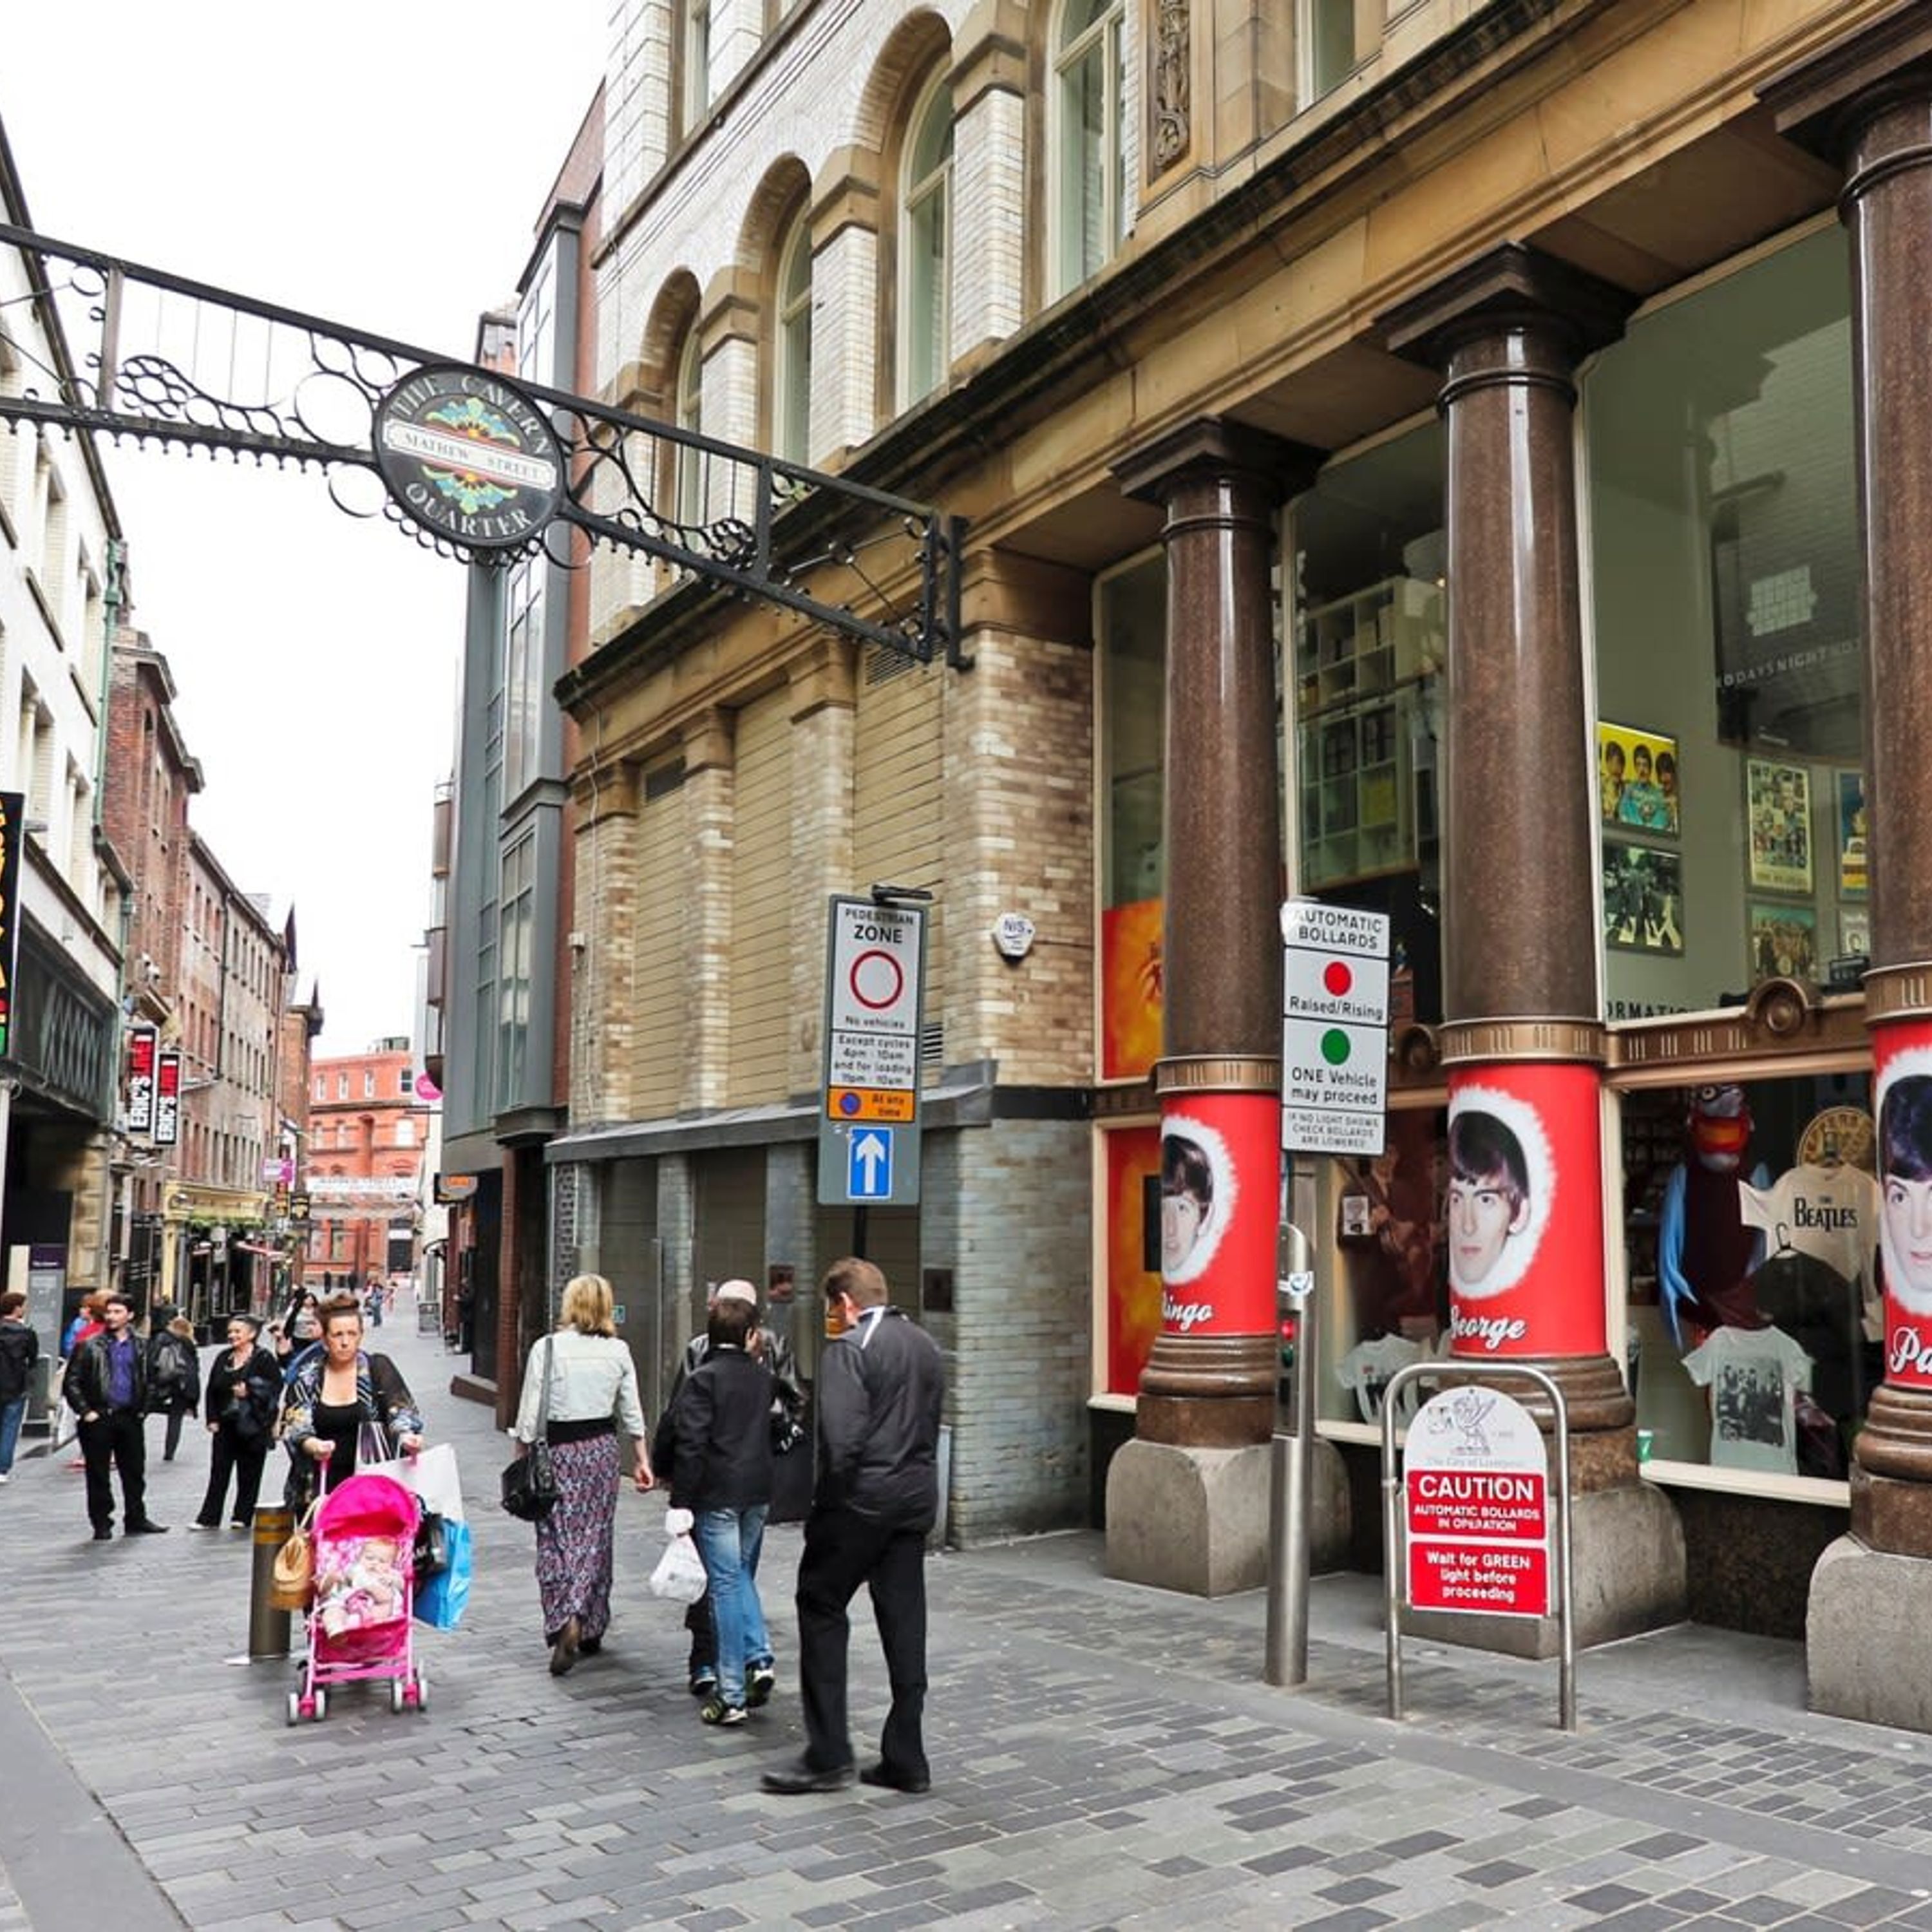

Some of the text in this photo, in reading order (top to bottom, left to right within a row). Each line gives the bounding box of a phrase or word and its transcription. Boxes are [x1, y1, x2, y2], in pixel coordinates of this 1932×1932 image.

[389, 375, 552, 455] THE CAVERN
[406, 483, 532, 537] QUARTER
[845, 907, 914, 925] PEDESTRIAN
[1302, 910, 1382, 933] UTOMATIC
[854, 924, 903, 943] ZONE
[1298, 926, 1378, 949] BOLLARDS
[1290, 996, 1383, 1021] Raised/Rising
[838, 1034, 911, 1050] Except cycles
[1292, 1066, 1377, 1088] ONE Vehicle
[1292, 1088, 1378, 1105] may proceed
[1292, 1122, 1324, 1134] CHECK
[1794, 1197, 1858, 1232] BEATLES
[1419, 1475, 1534, 1501] CAUTION
[1414, 1504, 1540, 1520] AUTOMATIC BOLLARDS
[1437, 1517, 1517, 1531] IN OPERATION
[1426, 1551, 1531, 1569] Wait for GREEN
[1440, 1568, 1517, 1586] light before
[1443, 1586, 1516, 1603] proceeding
